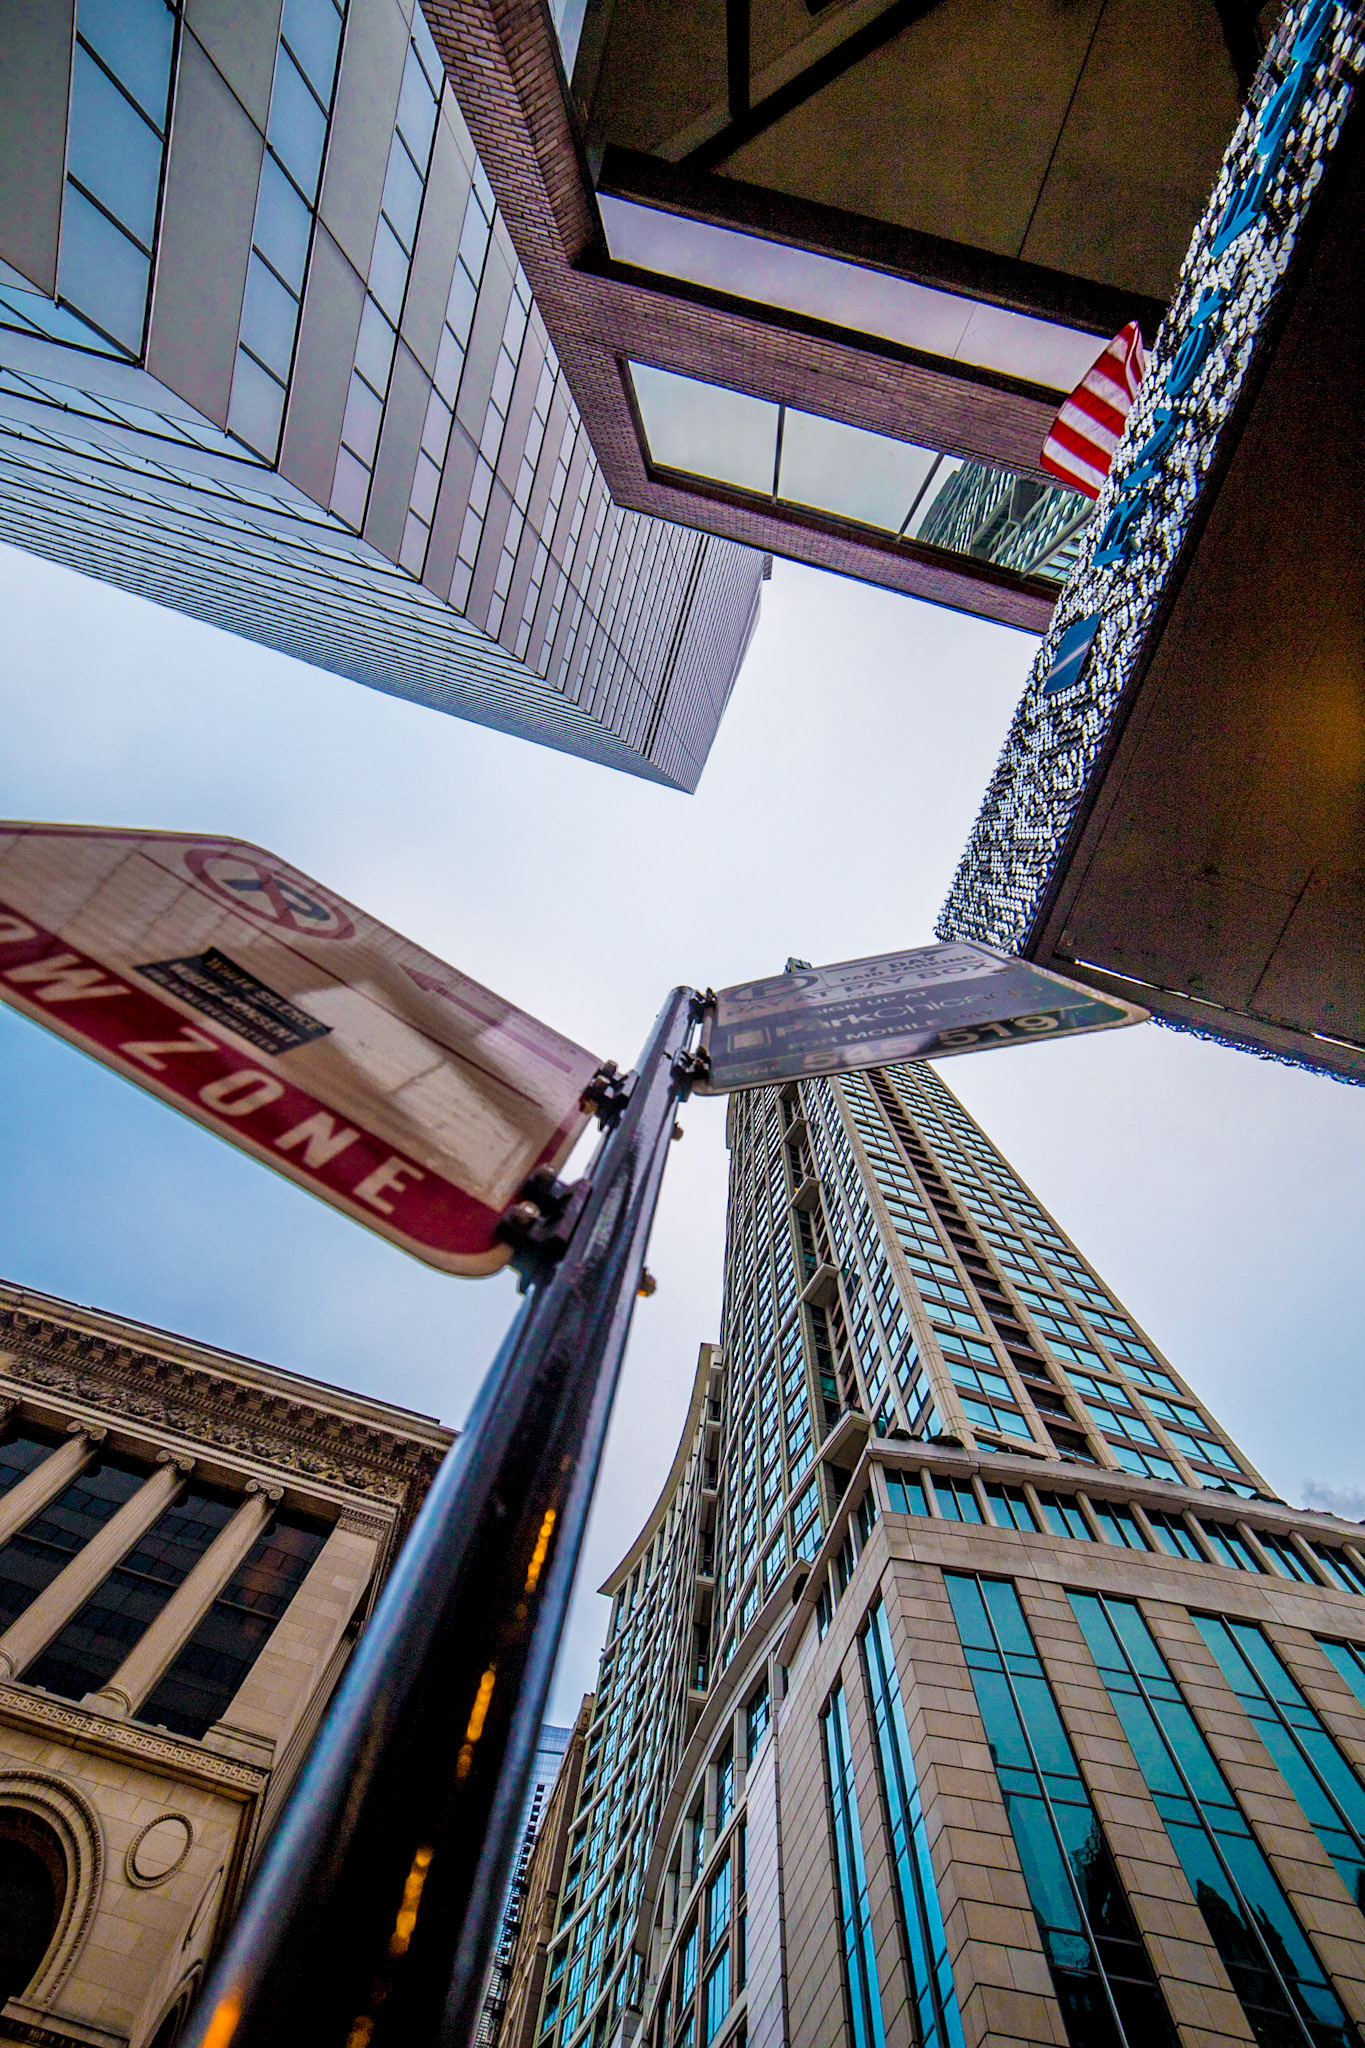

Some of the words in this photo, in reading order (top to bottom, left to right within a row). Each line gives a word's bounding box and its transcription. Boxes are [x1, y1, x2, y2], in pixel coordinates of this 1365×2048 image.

[1091, 285, 1228, 567] River
[839, 971, 884, 981] PAID
[889, 955, 977, 972] PARKING
[887, 955, 936, 967] DAY
[727, 999, 781, 1016] PAY
[794, 989, 831, 1001] AT
[844, 976, 909, 992] PAY
[916, 962, 994, 979] BOX
[865, 996, 896, 1005] UP
[902, 990, 931, 999] AT
[776, 984, 1045, 1037] ParkChica
[844, 1018, 940, 1040] MOBILE
[118, 1026, 425, 1214] ZONE
